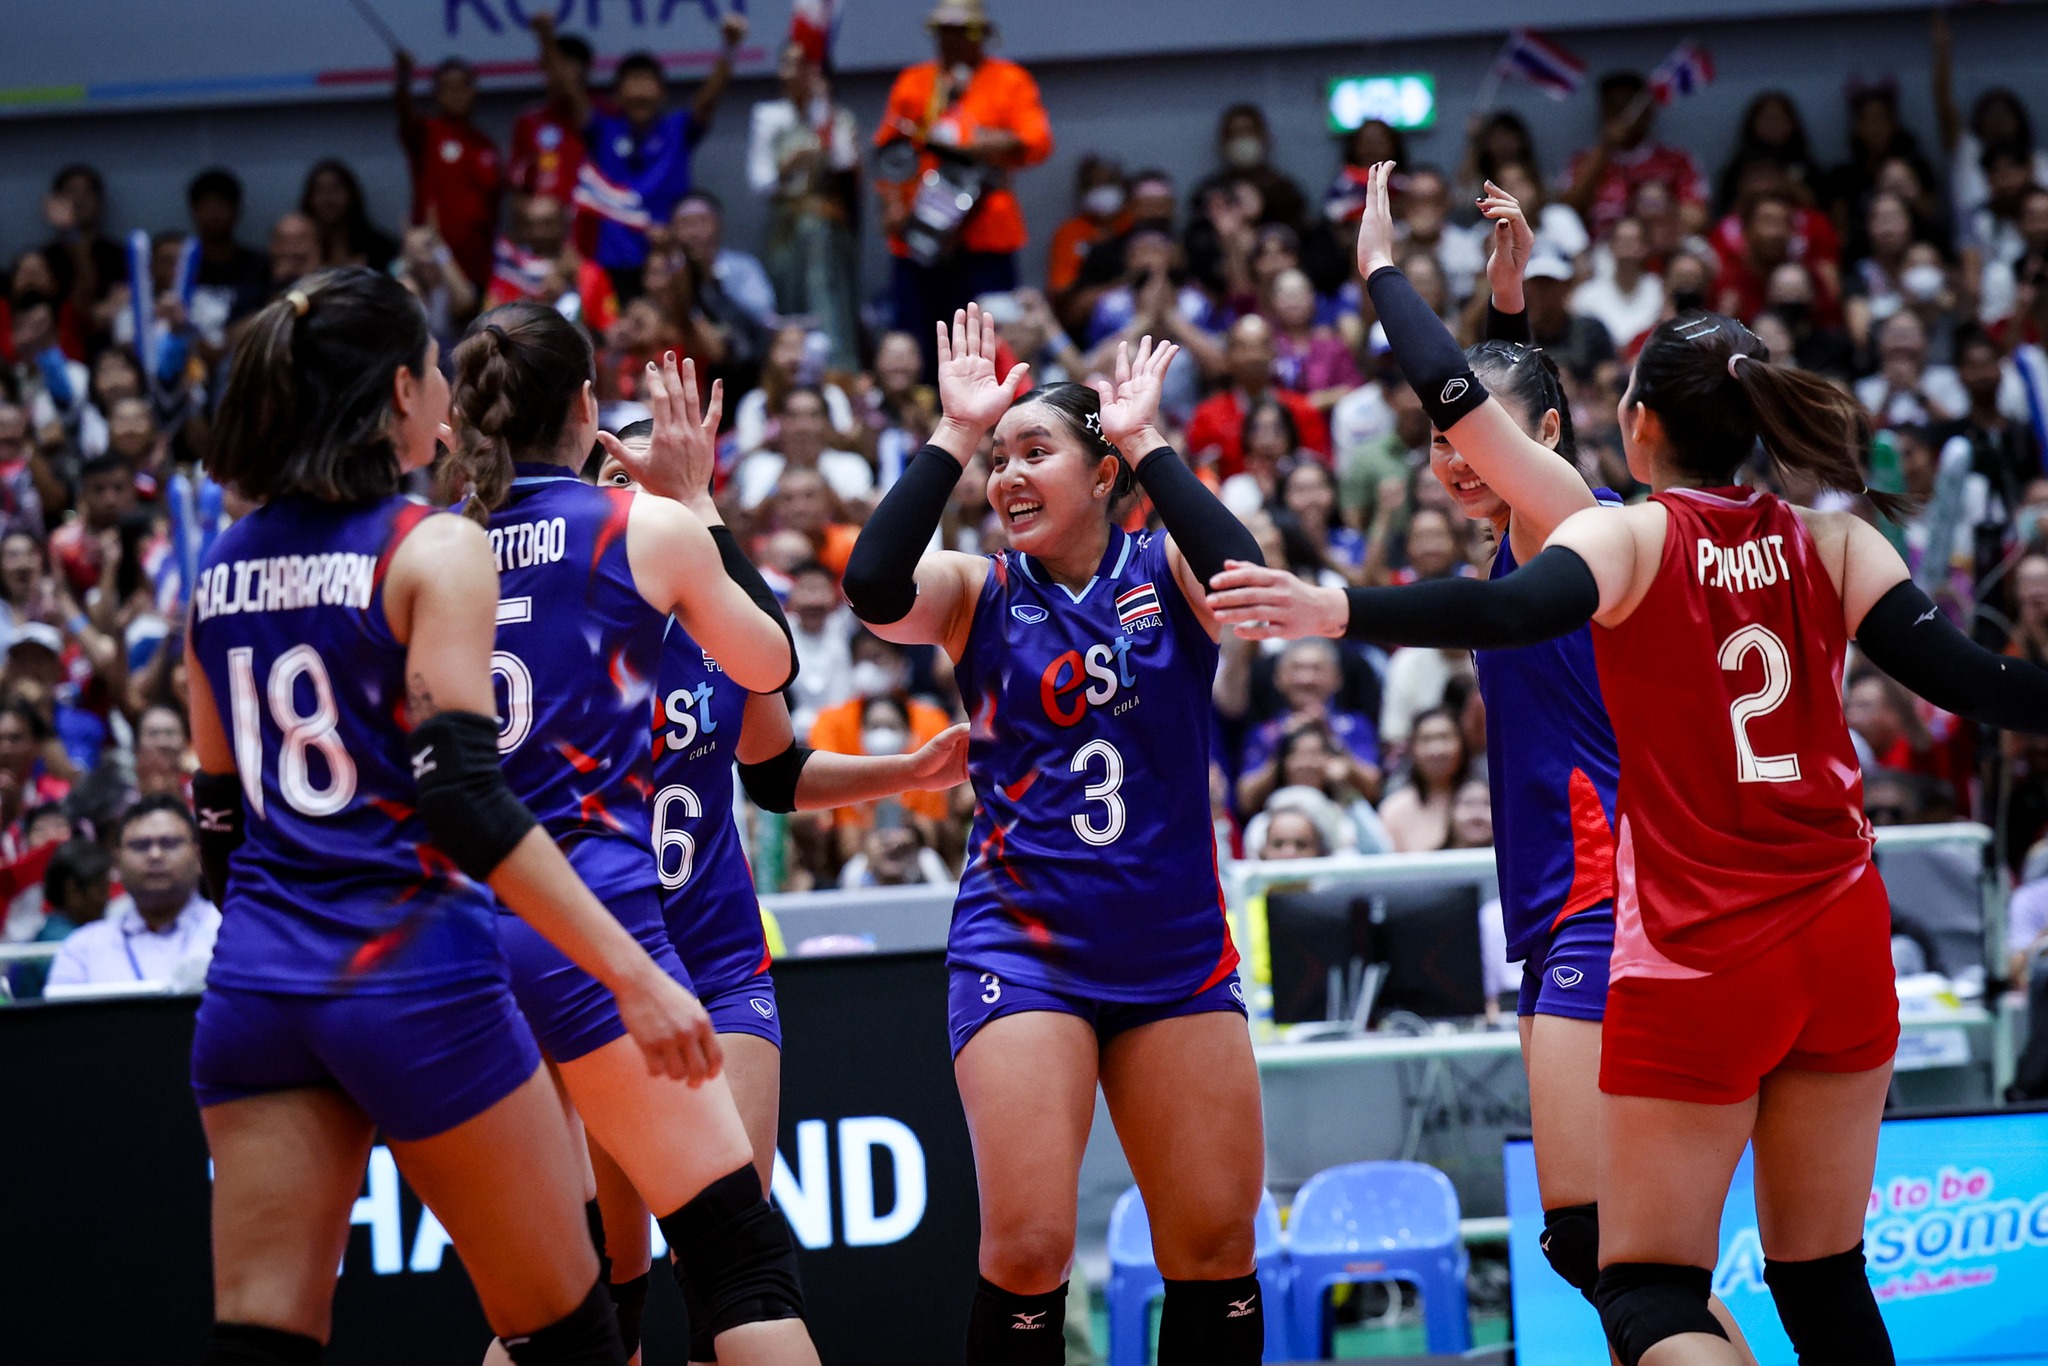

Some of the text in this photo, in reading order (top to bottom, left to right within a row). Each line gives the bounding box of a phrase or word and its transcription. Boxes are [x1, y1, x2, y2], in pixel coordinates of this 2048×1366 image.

[1122, 615, 1164, 635] THA
[1040, 636, 1137, 727] est
[1113, 695, 1140, 717] COLA
[1717, 623, 1802, 783] 2
[227, 643, 358, 821] 18
[688, 740, 716, 761] COLA
[1069, 738, 1126, 847] 3
[651, 783, 703, 891] 6
[979, 972, 1002, 1005] 3
[1941, 1173, 1986, 1203] be
